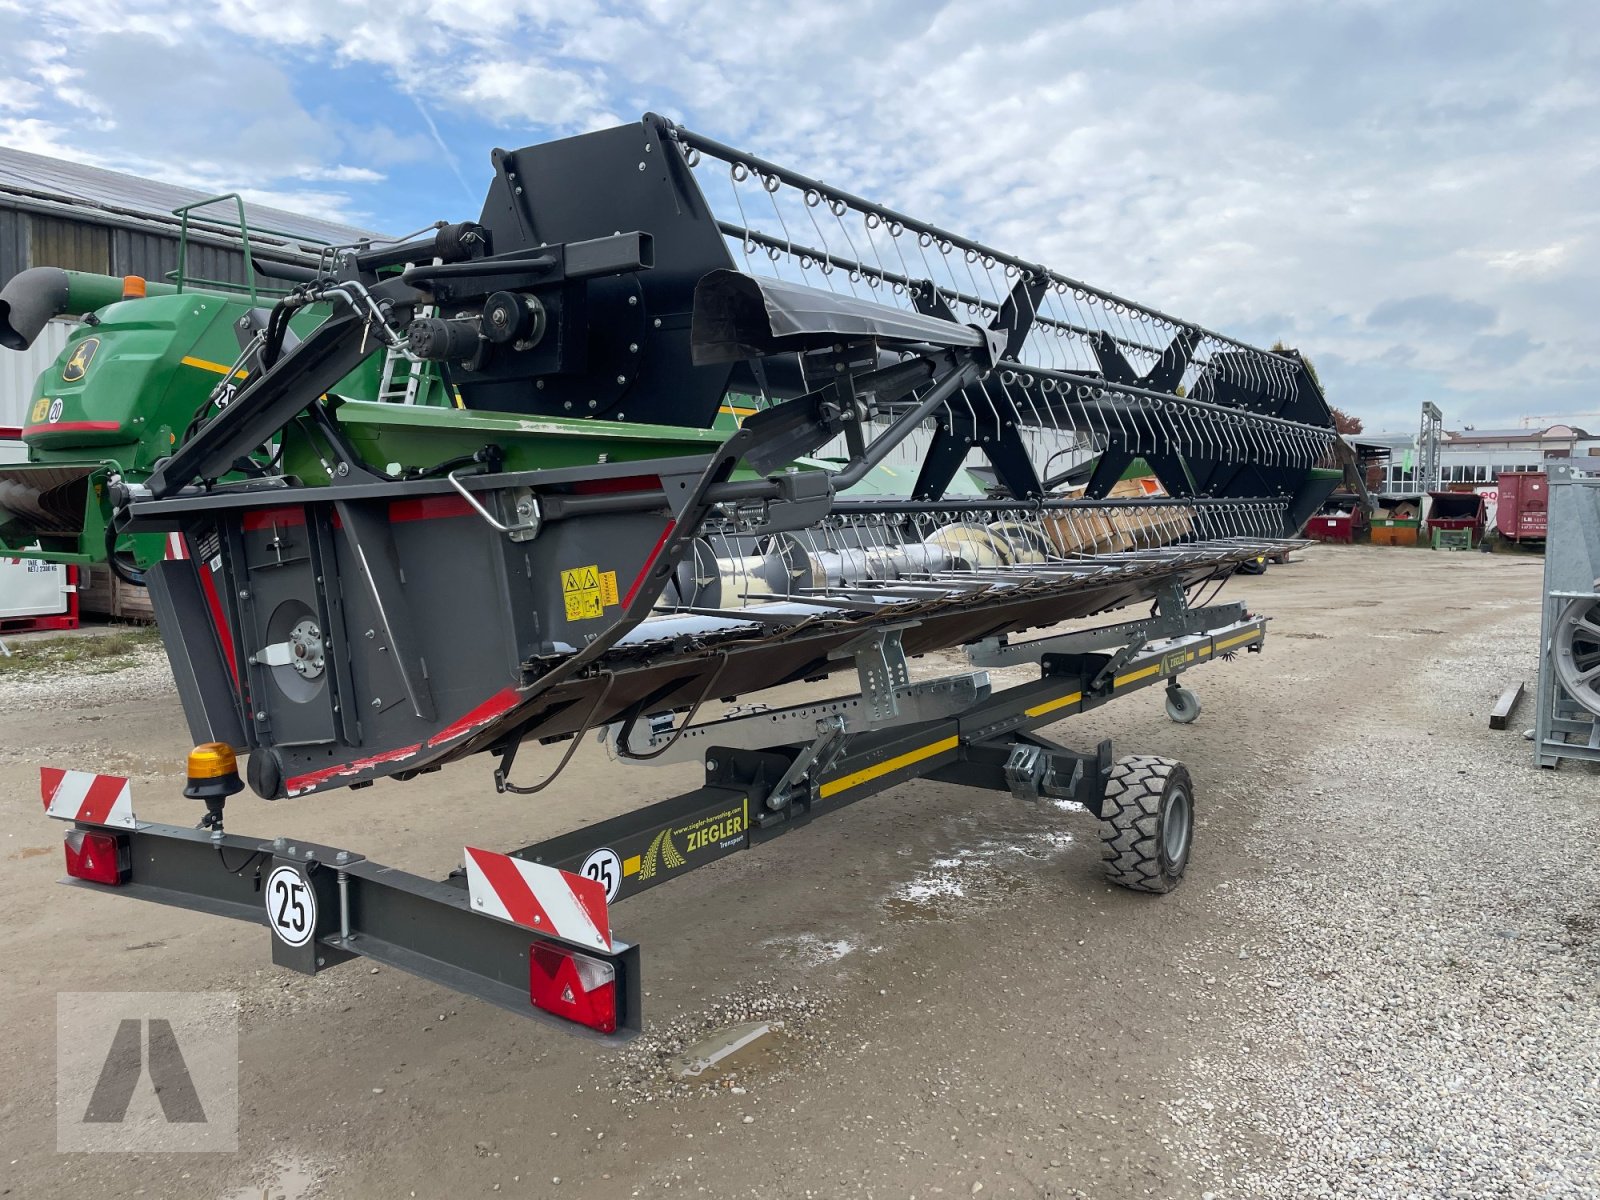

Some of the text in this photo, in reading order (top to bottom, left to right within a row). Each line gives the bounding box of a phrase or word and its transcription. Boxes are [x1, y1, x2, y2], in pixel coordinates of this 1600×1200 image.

[50, 402, 62, 420] 20
[673, 807, 742, 836] www.ziegler-harvesting.com
[686, 816, 742, 853] ZIEGLER
[719, 834, 744, 849] Transport
[587, 858, 612, 896] 25
[275, 879, 306, 933] 25
